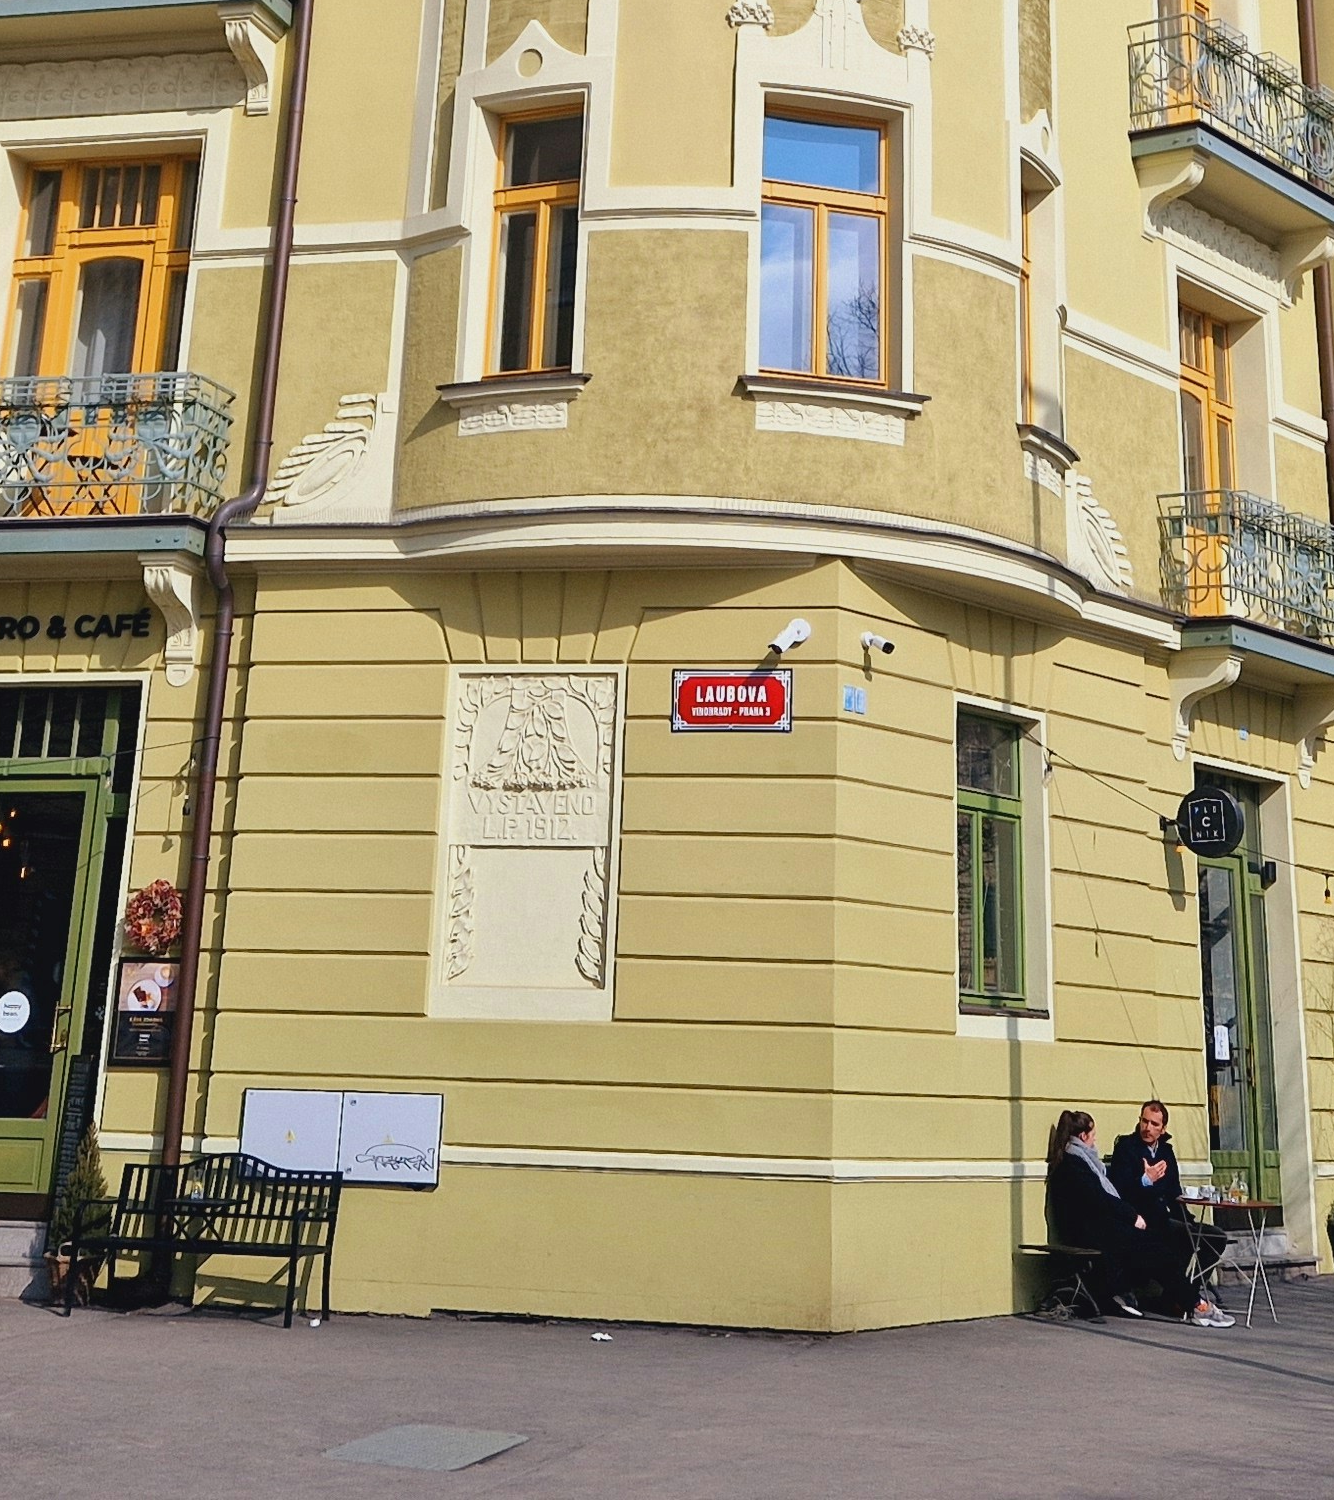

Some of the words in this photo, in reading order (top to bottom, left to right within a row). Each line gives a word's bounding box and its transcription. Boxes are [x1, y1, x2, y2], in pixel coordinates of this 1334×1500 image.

[46, 615, 66, 639] &
[74, 607, 151, 638] CAFÉ
[696, 685, 767, 703] LAUBOVA
[692, 706, 733, 717] VINOHRADY
[739, 706, 764, 717] PRAHA
[765, 706, 770, 717] 3
[467, 792, 596, 816] VYSTAVENO
